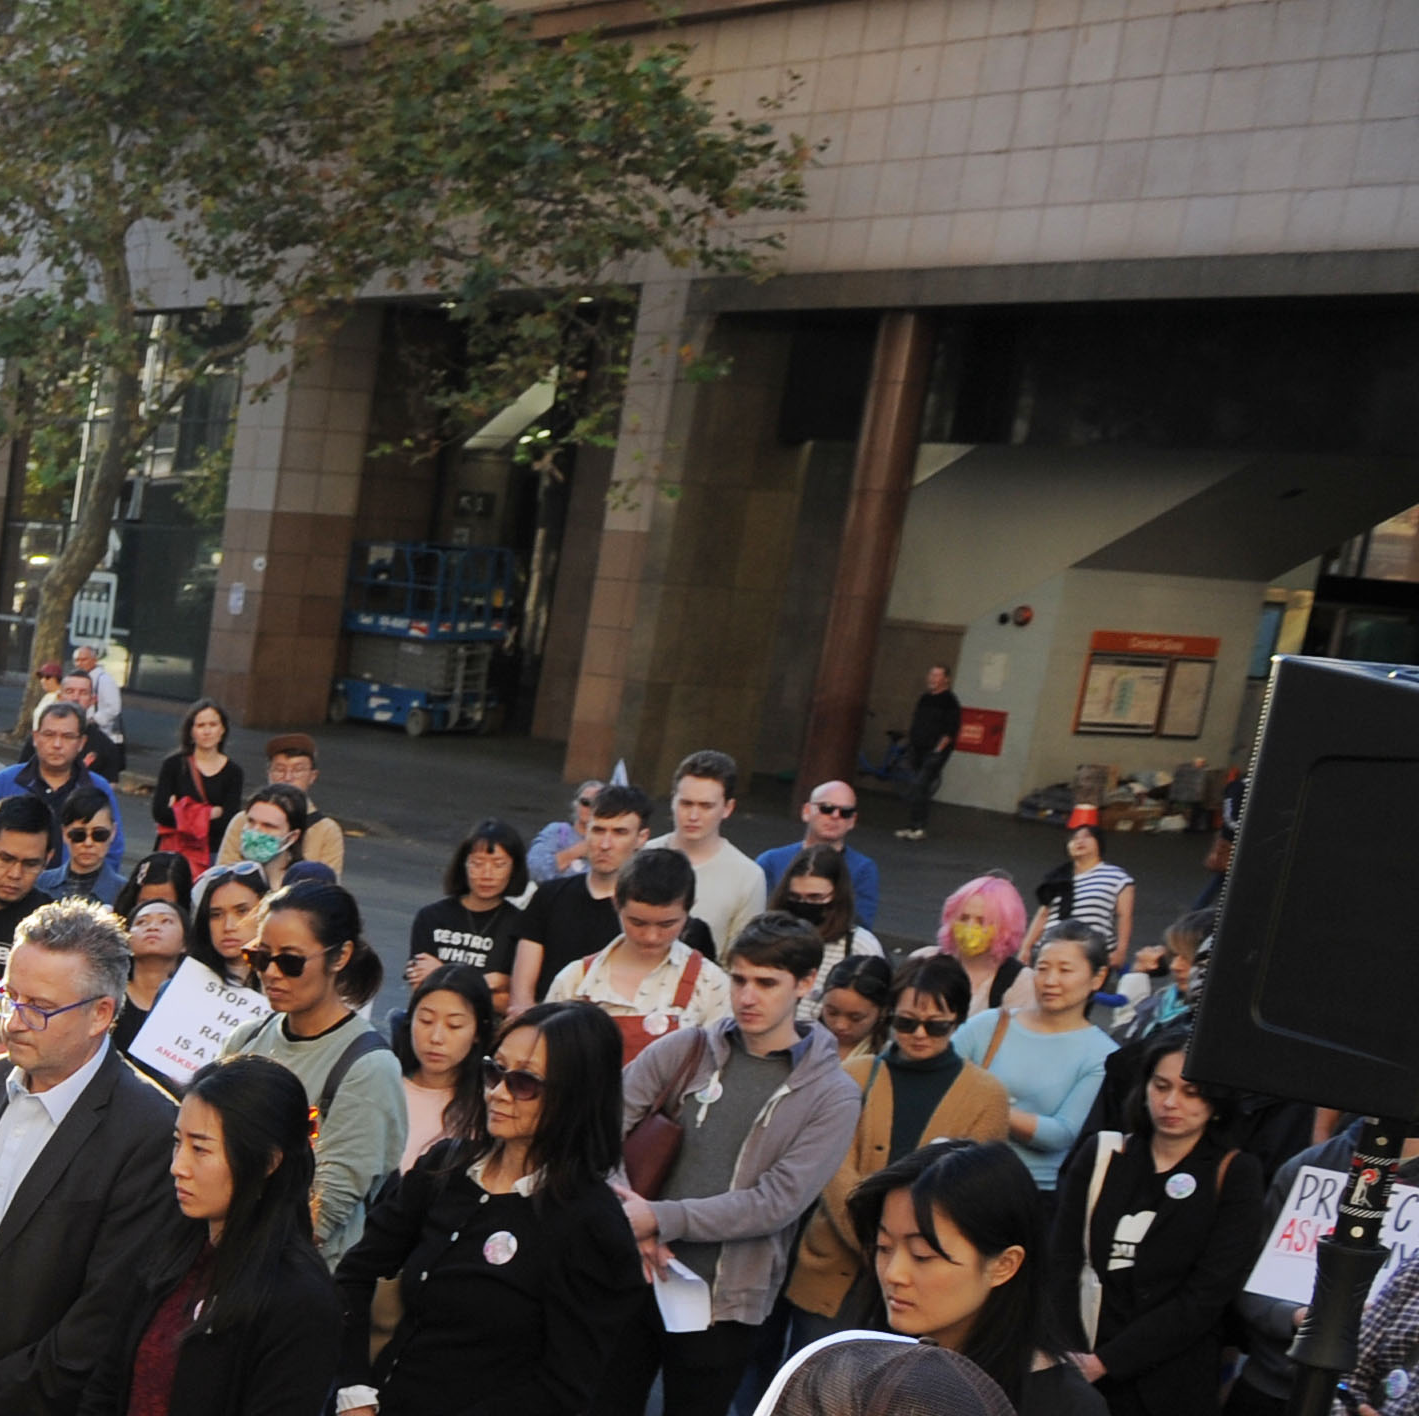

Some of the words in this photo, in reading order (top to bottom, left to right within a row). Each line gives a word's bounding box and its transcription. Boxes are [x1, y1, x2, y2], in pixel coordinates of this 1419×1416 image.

[205, 981, 248, 1007] STOP
[217, 1011, 240, 1028] HA
[155, 1046, 201, 1072] ANAKBA
[174, 1035, 192, 1051] IS
[193, 1049, 205, 1059] A
